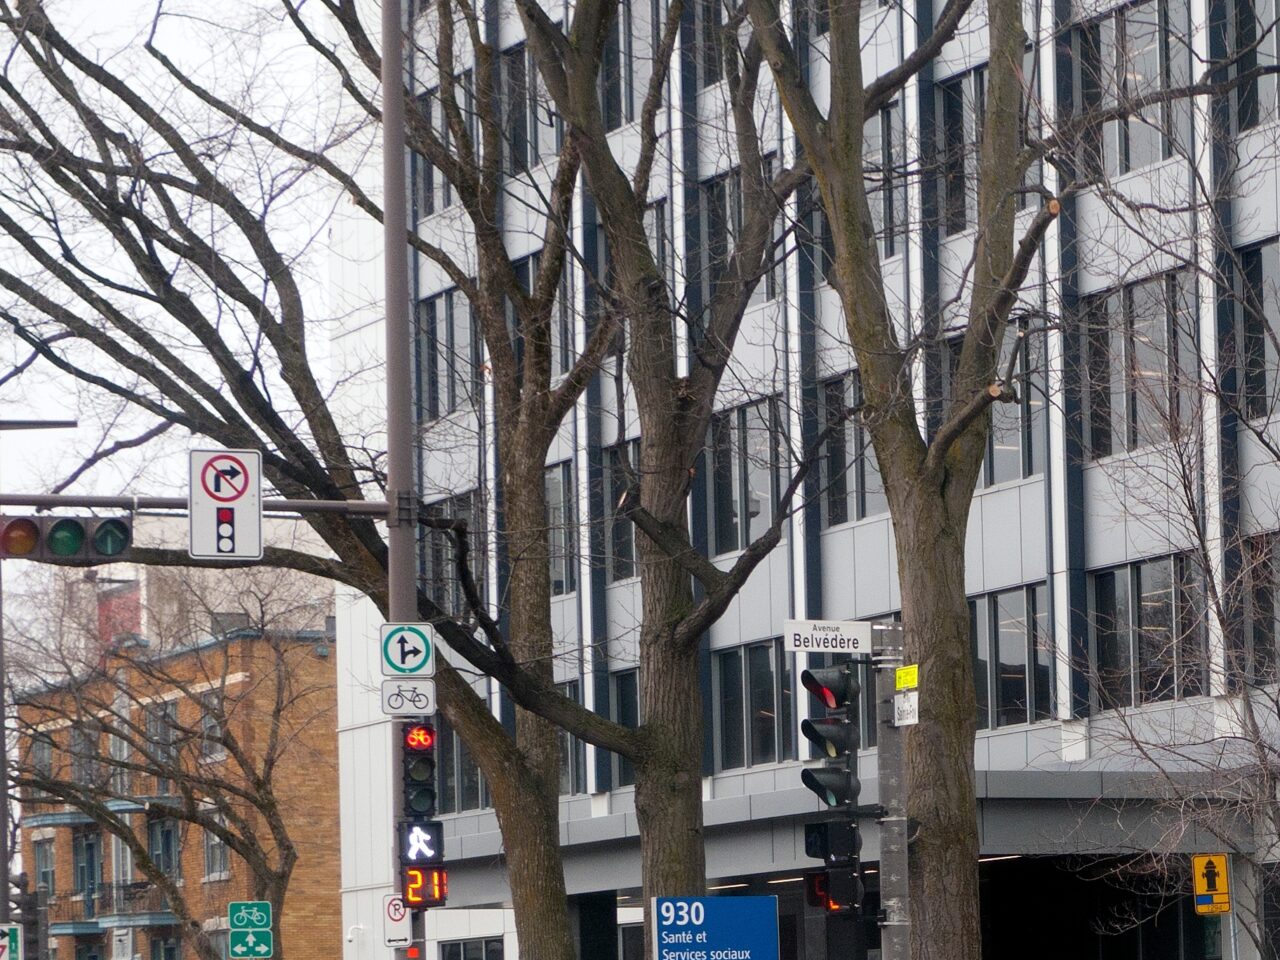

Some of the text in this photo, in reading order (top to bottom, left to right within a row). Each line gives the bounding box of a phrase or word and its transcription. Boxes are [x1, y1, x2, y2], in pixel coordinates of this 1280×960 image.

[812, 624, 840, 632] Avenue
[793, 633, 859, 649] Belvédère
[406, 870, 440, 902] 21
[661, 901, 705, 926] 930
[661, 930, 707, 944] Santé et
[710, 947, 751, 960] sociaux
